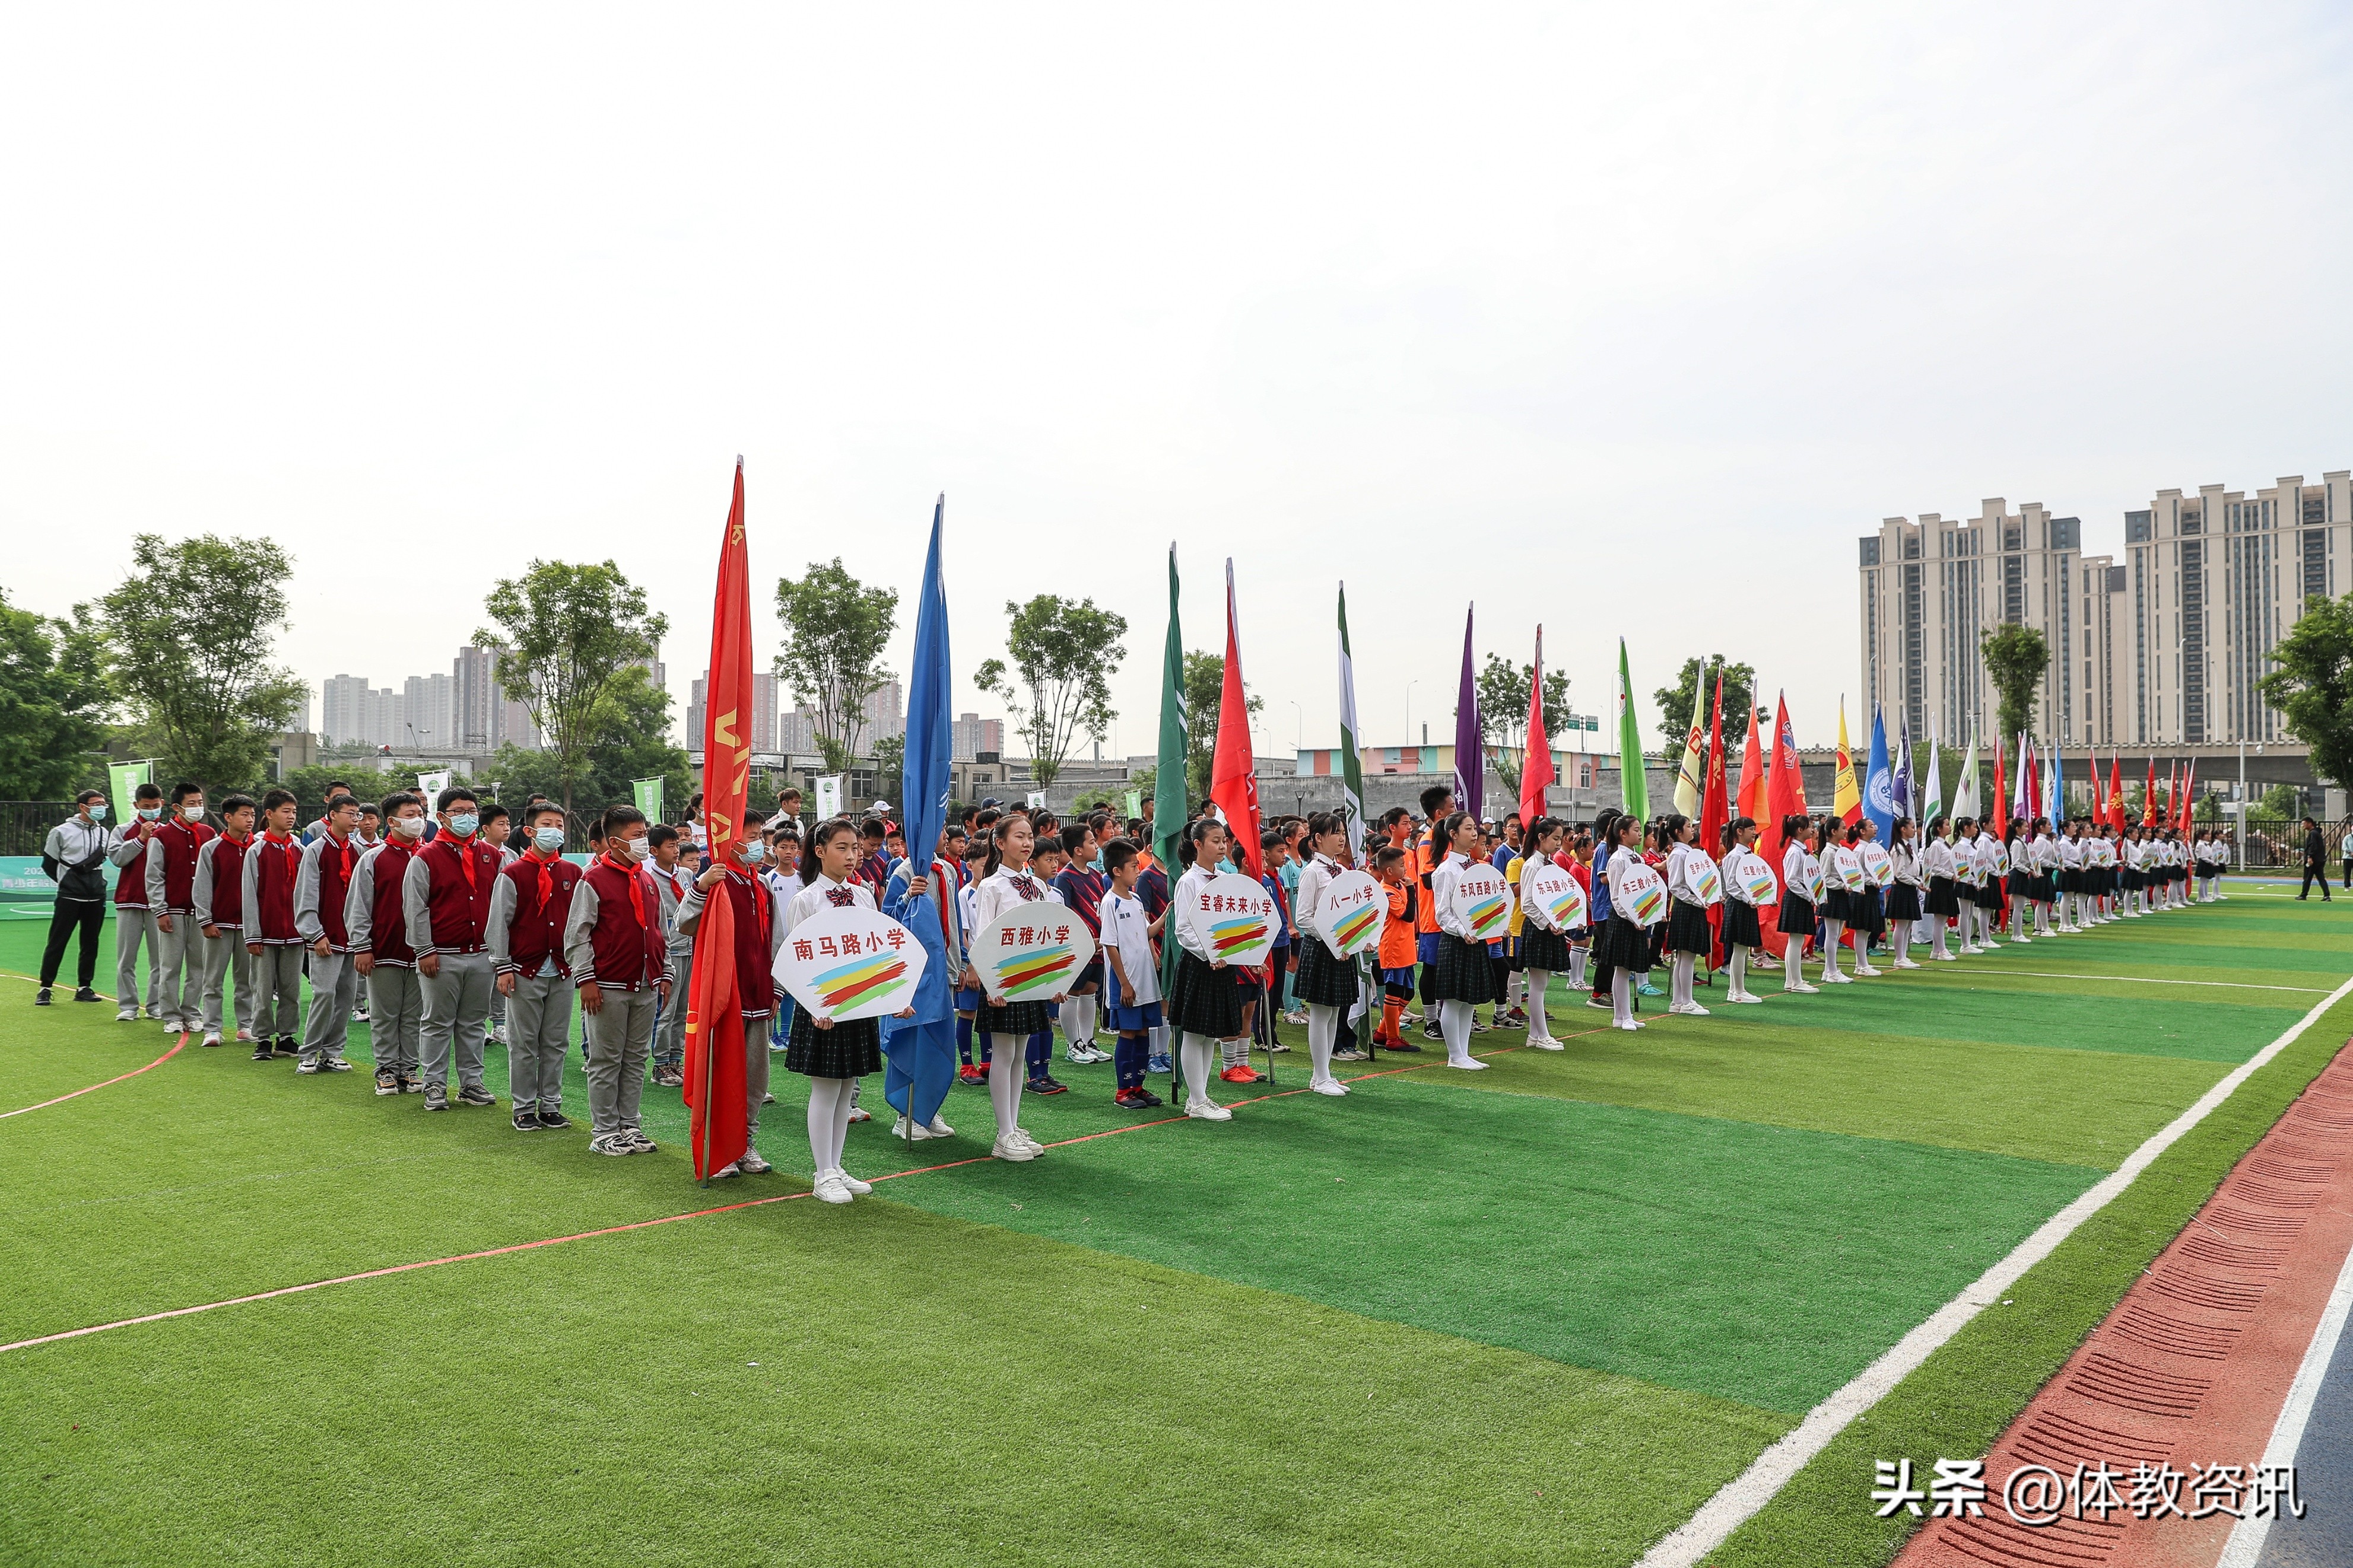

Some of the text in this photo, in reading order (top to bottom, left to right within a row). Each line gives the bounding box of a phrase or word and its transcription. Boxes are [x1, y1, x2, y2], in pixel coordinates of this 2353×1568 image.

[24, 867, 44, 876] 202
[1743, 866, 1767, 875] 红星小学
[1460, 879, 1506, 898] 东风西路小学
[1536, 877, 1576, 895] 东马路小学
[1622, 873, 1659, 895] 东三教小学
[1200, 893, 1272, 917] 宝睿未来小学
[1330, 884, 1373, 911] 八一小学
[792, 928, 906, 962] 南马路小学
[1001, 925, 1070, 946] 西雅小学
